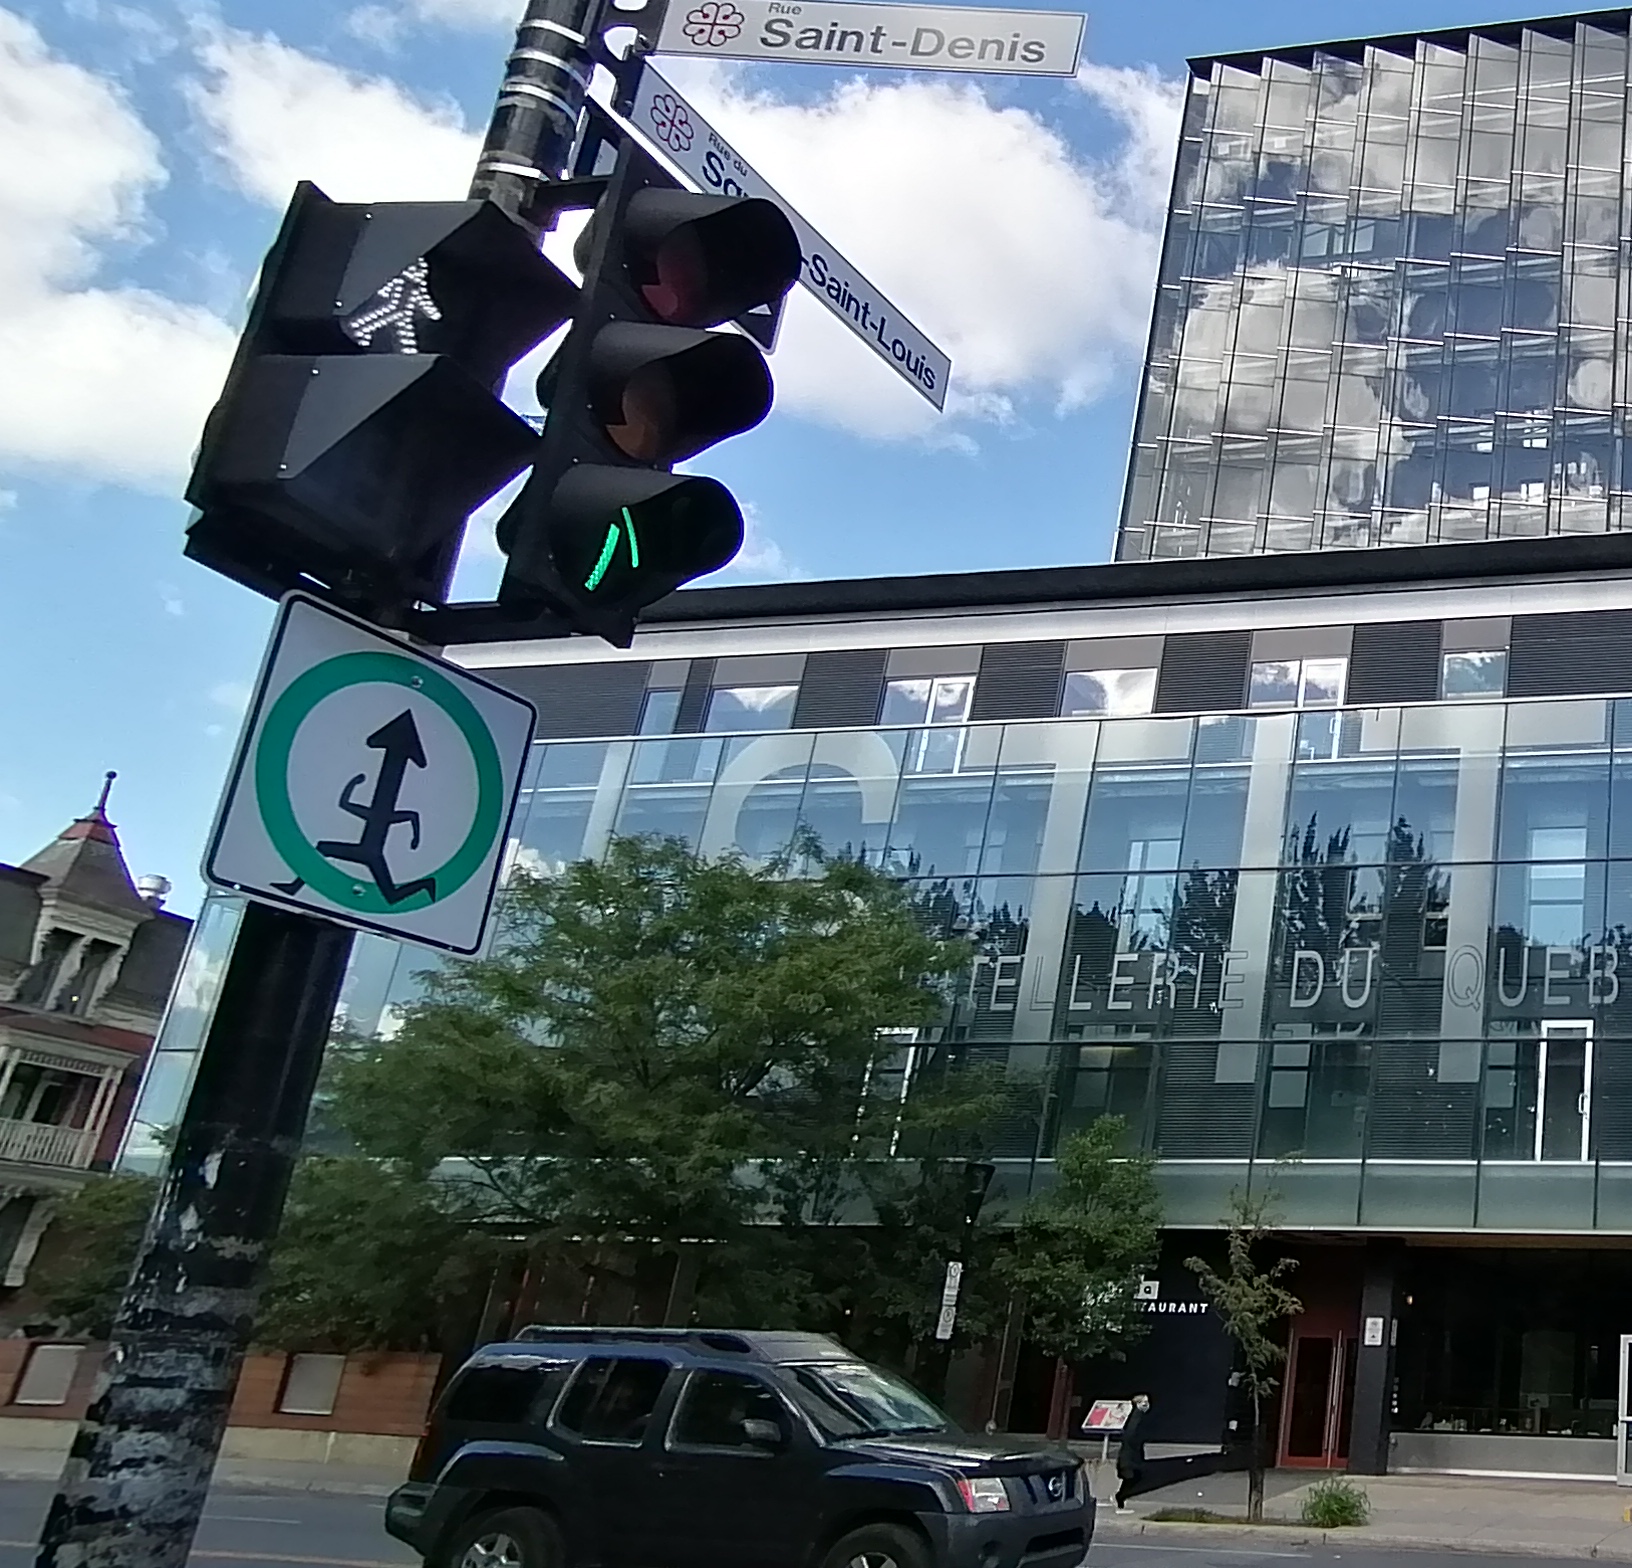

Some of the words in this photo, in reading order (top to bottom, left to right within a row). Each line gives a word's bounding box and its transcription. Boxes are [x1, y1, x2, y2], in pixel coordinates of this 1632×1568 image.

[768, 1, 802, 15] Rue
[760, 18, 1046, 63] Saint-Denis
[708, 131, 732, 162] Rue
[733, 157, 748, 178] du
[969, 950, 1249, 1012] TELLERIE
[1290, 946, 1377, 1009] DU
